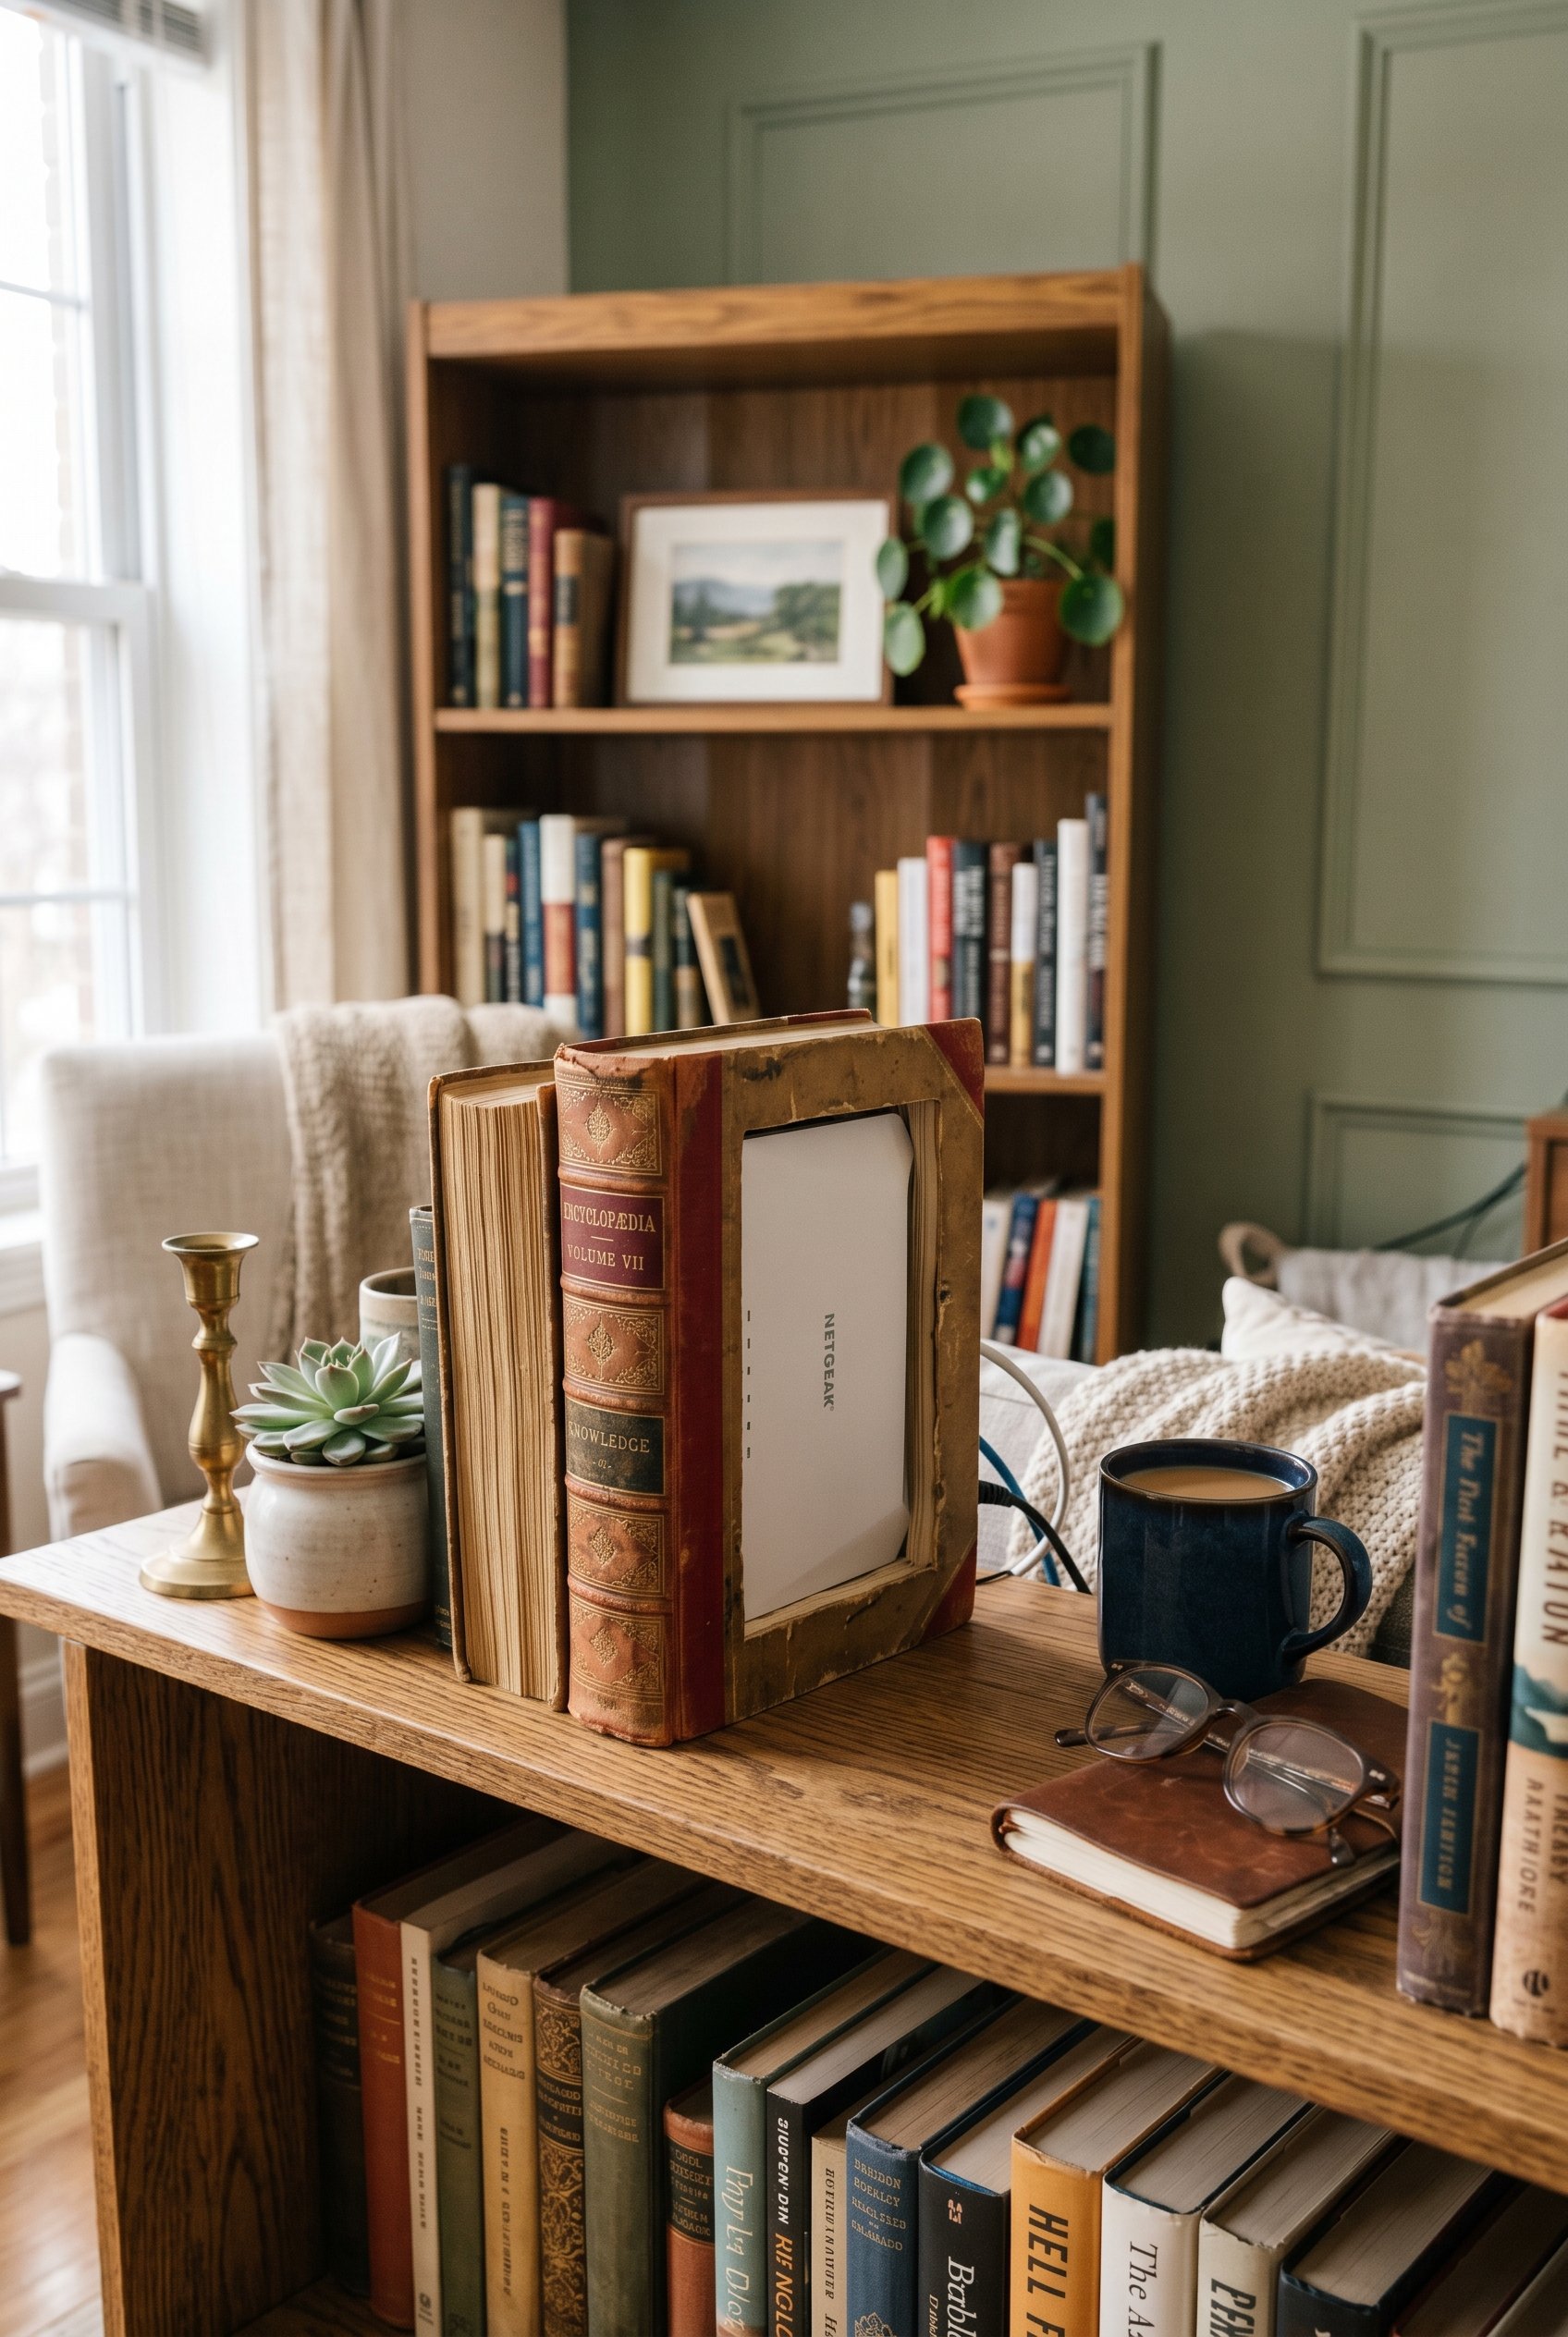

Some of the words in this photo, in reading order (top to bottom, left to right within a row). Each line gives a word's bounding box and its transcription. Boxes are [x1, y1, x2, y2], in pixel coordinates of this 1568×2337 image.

[568, 1243, 616, 1267] VOLUME
[621, 1254, 644, 1270] VII
[568, 1421, 650, 1453] KNOWLEDGE
[1027, 2204, 1069, 2299] HELL
[1129, 2241, 1158, 2301] The
